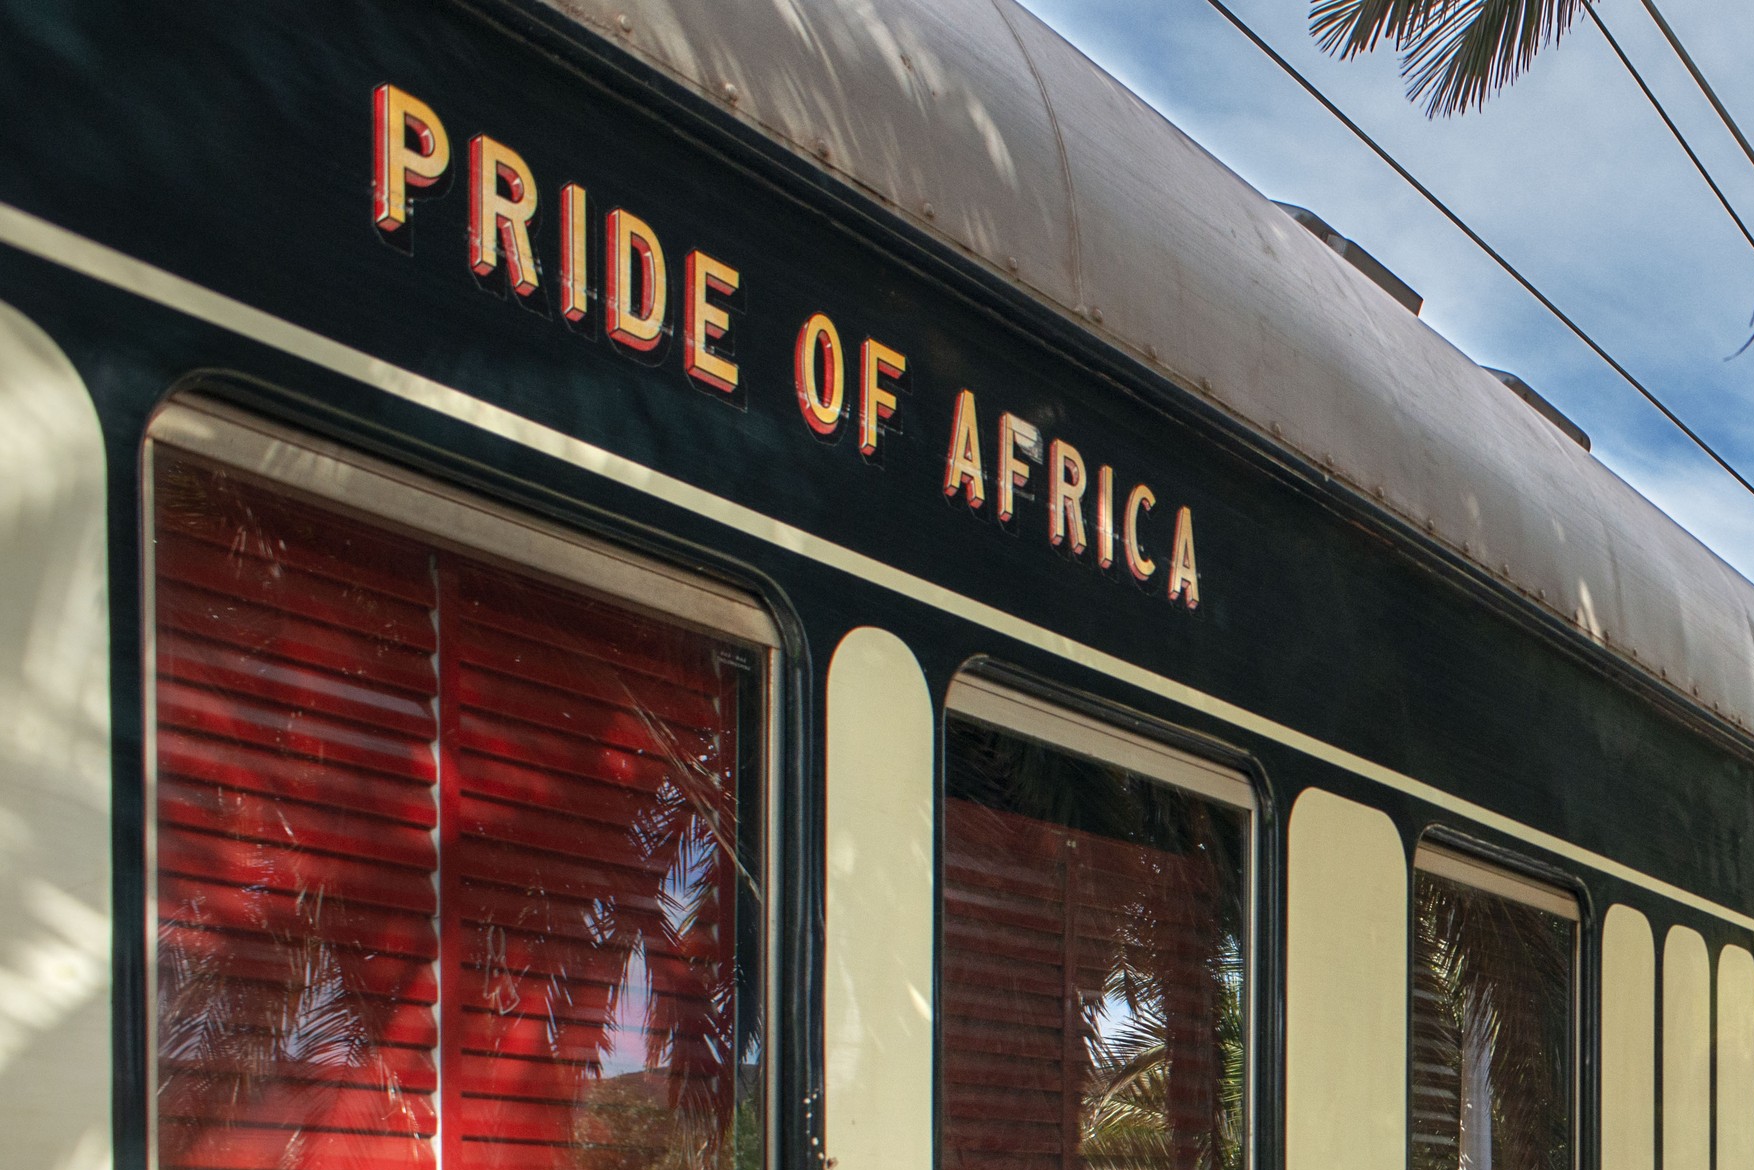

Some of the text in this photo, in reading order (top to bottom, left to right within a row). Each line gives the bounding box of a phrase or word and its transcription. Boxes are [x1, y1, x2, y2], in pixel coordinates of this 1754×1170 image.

[373, 83, 1200, 610] PRIDE OF AFRICA
